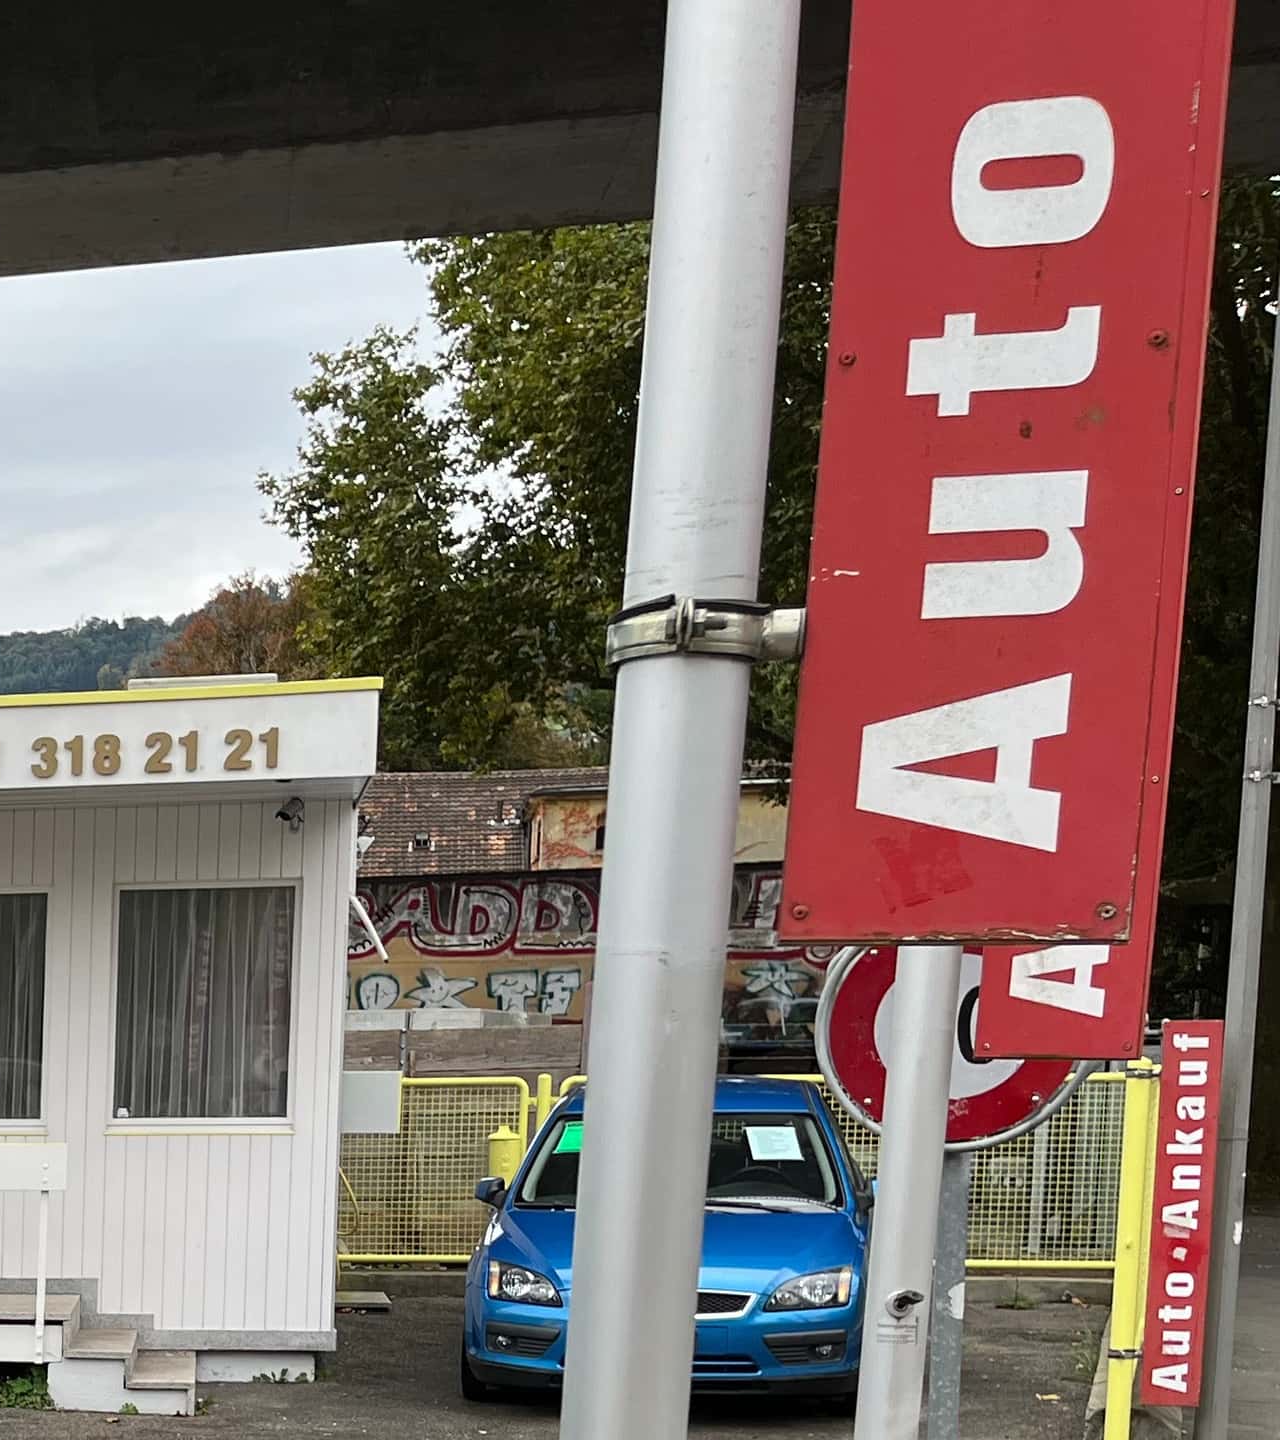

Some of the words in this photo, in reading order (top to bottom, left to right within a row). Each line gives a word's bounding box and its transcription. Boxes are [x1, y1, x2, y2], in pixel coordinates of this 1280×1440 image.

[855, 96, 1115, 853] Auto
[31, 734, 121, 778] 318
[143, 730, 199, 774] 21
[224, 727, 279, 771] 21
